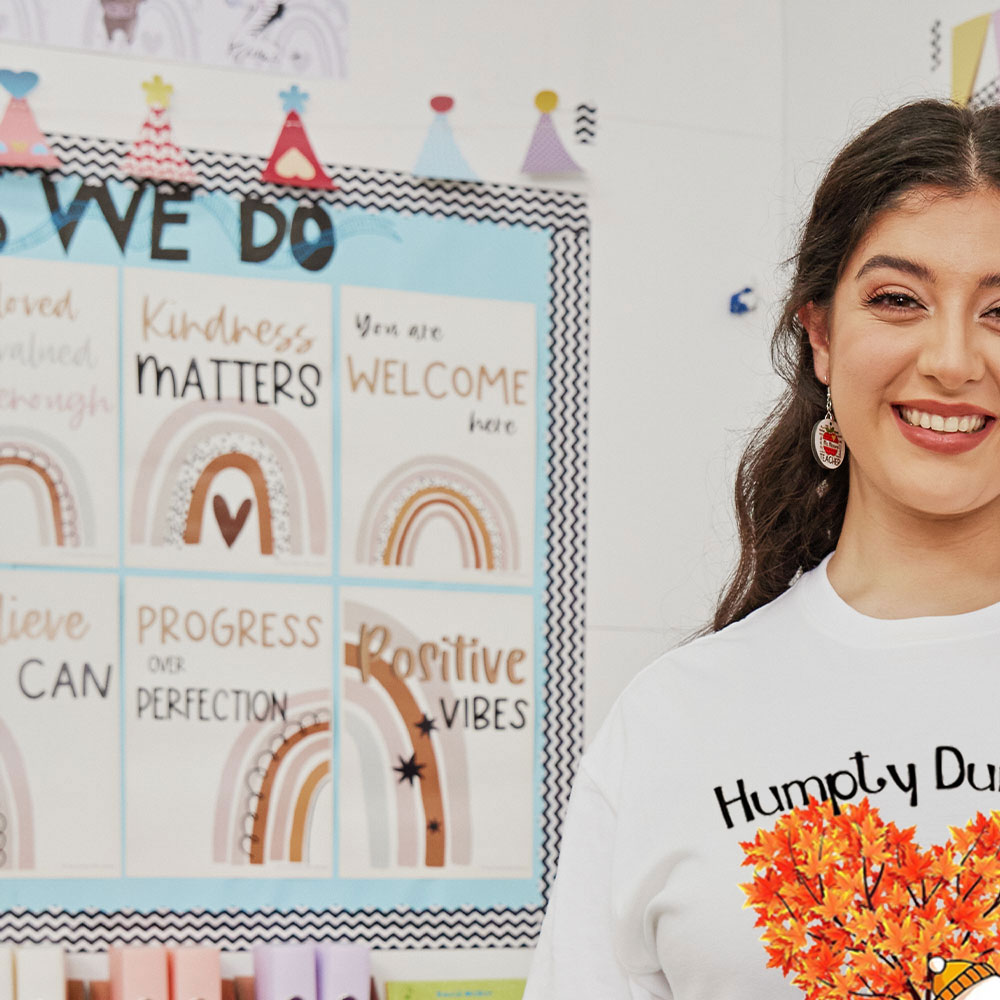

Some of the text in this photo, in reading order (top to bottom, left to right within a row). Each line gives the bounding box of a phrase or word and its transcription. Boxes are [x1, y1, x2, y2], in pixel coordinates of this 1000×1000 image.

[41, 175, 193, 260] WE
[240, 198, 335, 271] DO
[142, 296, 315, 354] Kindness
[347, 355, 529, 406] WELCOME
[138, 605, 322, 648] PROGRESS
[149, 656, 185, 674] OVER
[360, 624, 526, 684] Positive
[19, 659, 111, 699] CAN
[137, 687, 287, 722] PERFECTION
[440, 696, 528, 730] VIBES
[714, 751, 918, 829] Humpty
